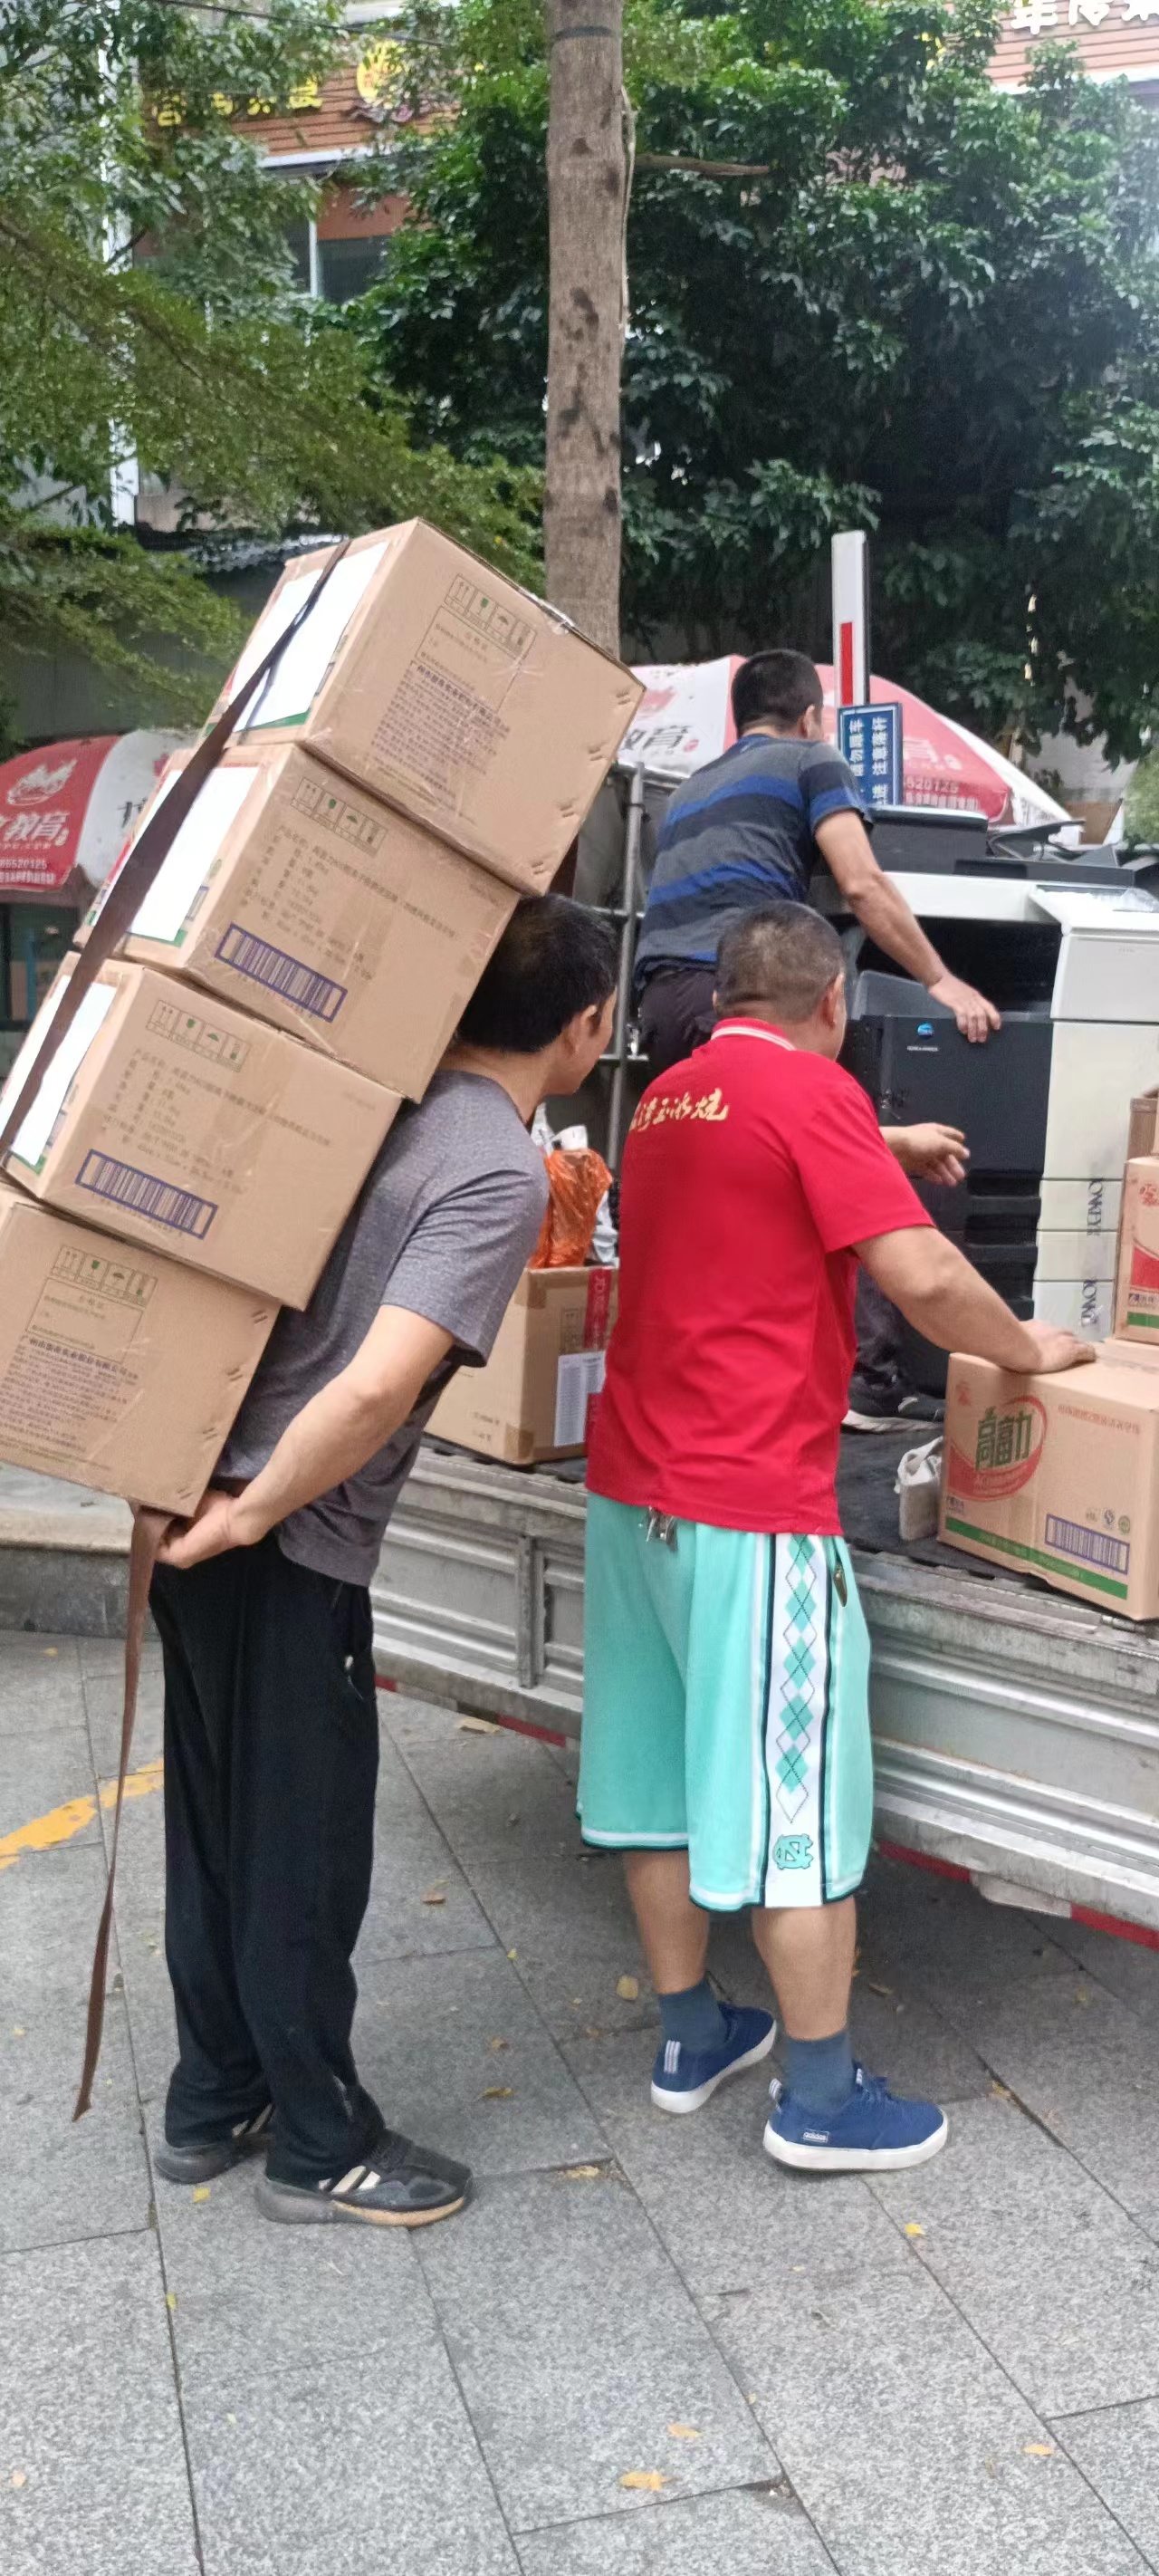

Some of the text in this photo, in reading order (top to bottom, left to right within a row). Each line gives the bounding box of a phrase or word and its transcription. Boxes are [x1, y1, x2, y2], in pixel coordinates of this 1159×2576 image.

[904, 775, 960, 794] 520125
[0, 810, 70, 841] 教育
[975, 1405, 1033, 1471] 高富力
